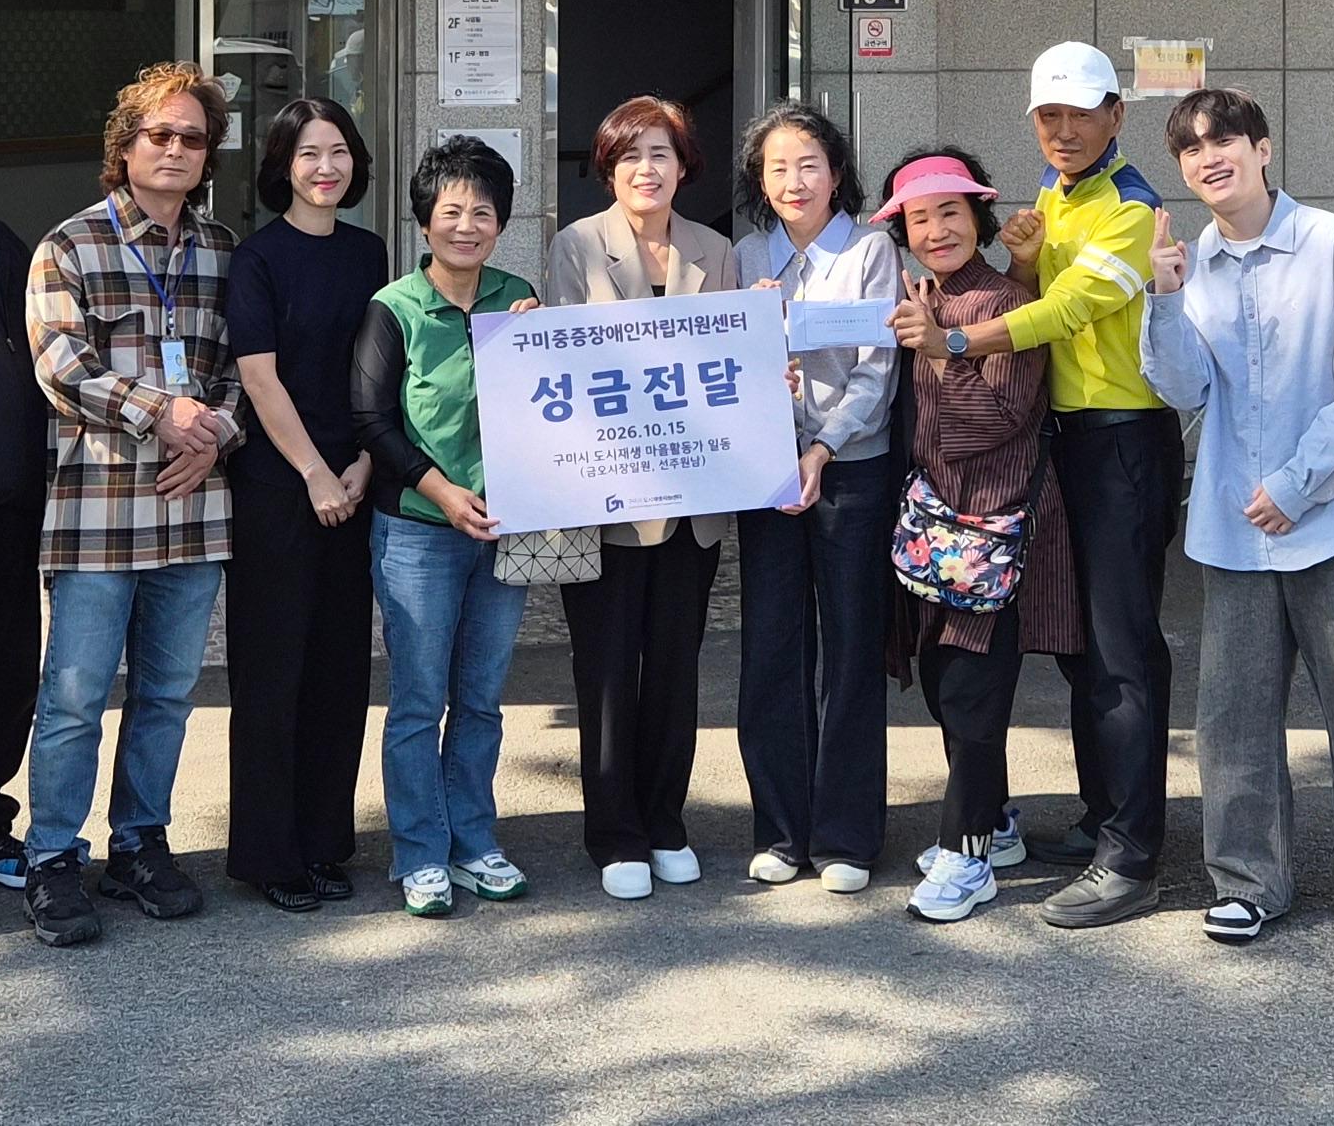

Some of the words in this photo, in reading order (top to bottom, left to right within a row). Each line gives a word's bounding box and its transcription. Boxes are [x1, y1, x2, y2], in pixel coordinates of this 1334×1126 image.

[448, 17, 460, 29] 2F
[449, 52, 460, 63] 1F
[512, 311, 747, 352] 구미중증장애인자립지원센터
[530, 357, 743, 423] 성금전달
[596, 421, 686, 442] 2026.10.15
[553, 450, 589, 467] 구미시
[594, 445, 642, 463] 도시재생
[645, 439, 704, 458] 마을활동가
[707, 437, 732, 452] 일동
[580, 460, 656, 479] (금오시장일원,
